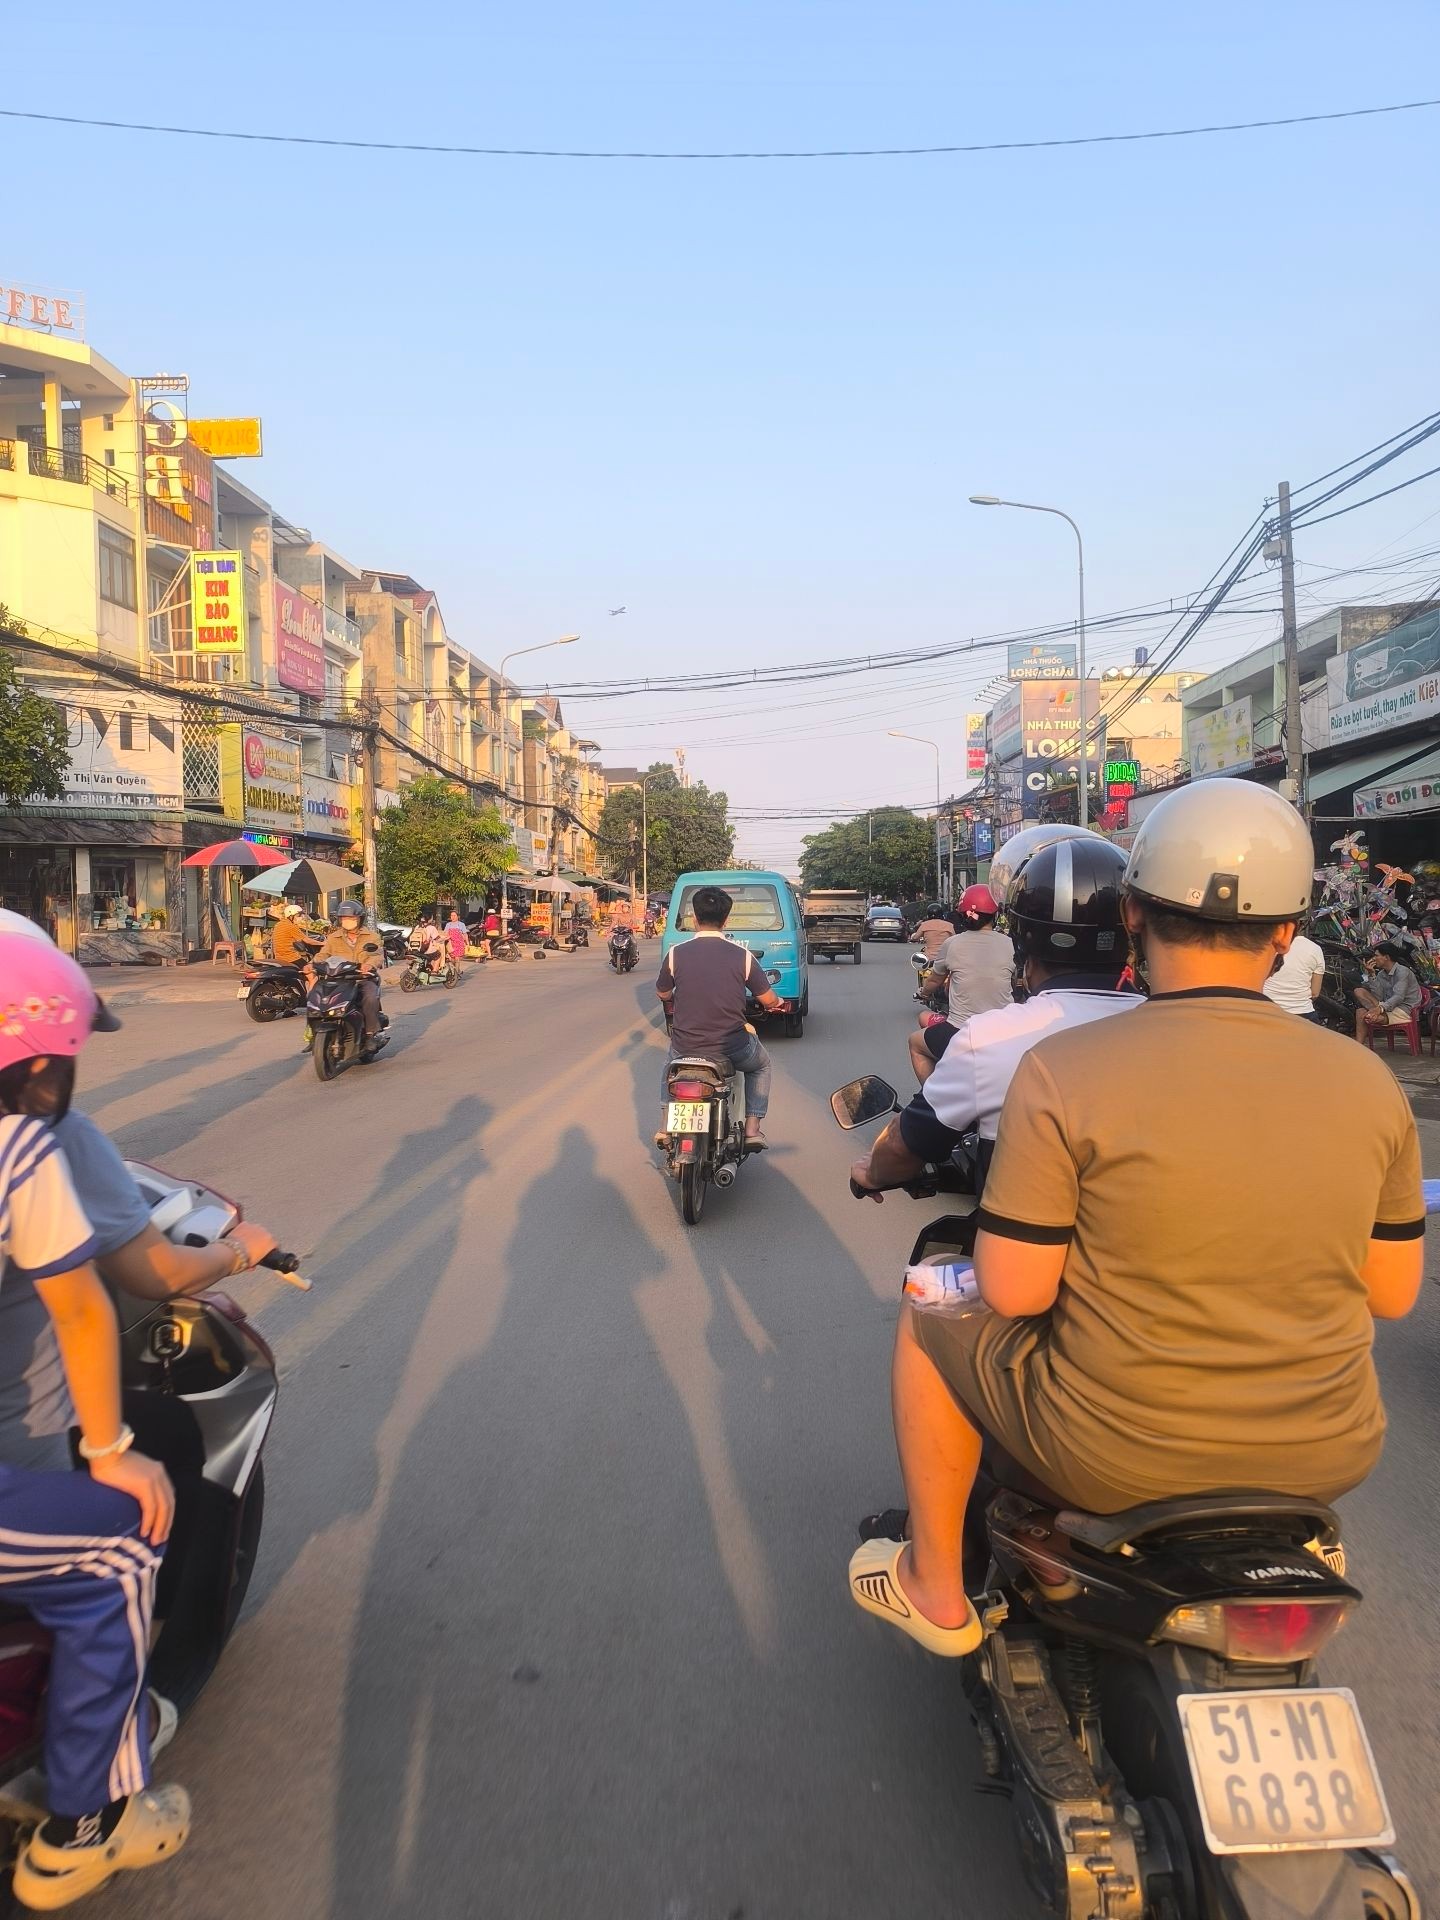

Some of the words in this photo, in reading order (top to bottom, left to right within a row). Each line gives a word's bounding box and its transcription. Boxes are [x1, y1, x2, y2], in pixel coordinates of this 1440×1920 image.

[0, 286, 73, 329] FEE
[205, 580, 229, 597] KIM
[206, 599, 229, 619] BẢO
[198, 626, 238, 643] KHANG
[1344, 716, 1351, 726] xe
[1383, 698, 1398, 716] thay
[1027, 717, 1053, 731] NHÀ
[1026, 739, 1096, 758] LONG
[74, 773, 92, 785] Thị
[156, 797, 179, 807] HCM
[674, 1104, 704, 1117] 52-N3
[673, 1118, 703, 1131] 2616
[1244, 1566, 1326, 1582] YAMAHA
[1208, 1700, 1338, 1765] 51-N1
[1224, 1768, 1357, 1835] 6838
